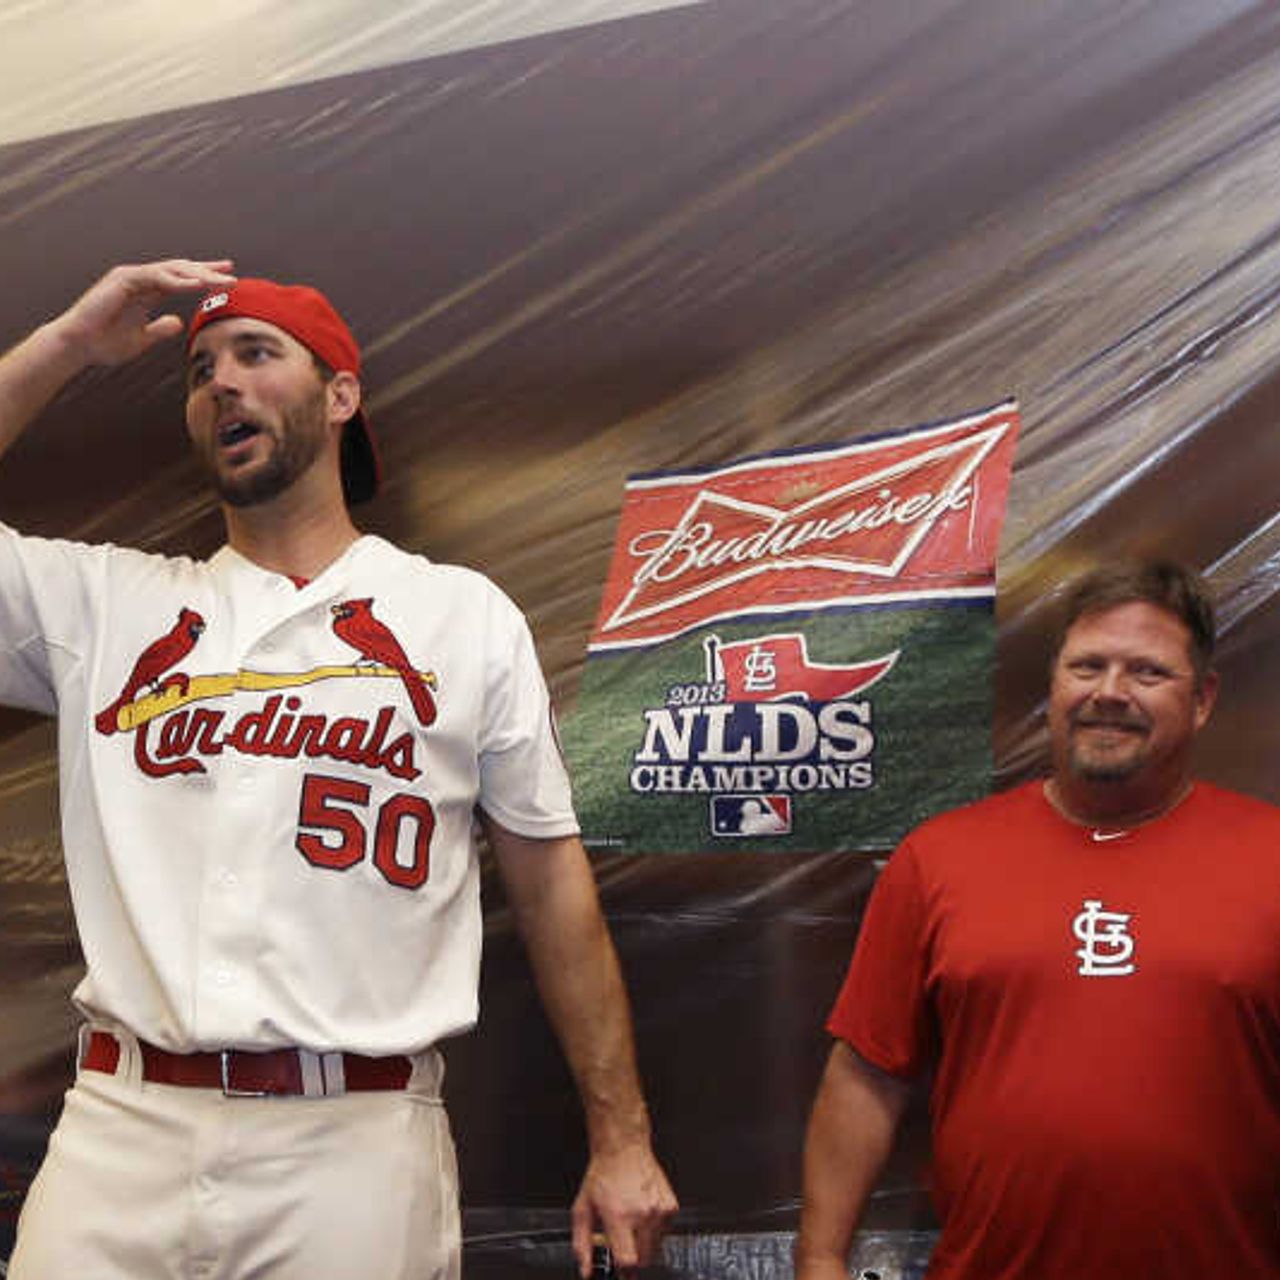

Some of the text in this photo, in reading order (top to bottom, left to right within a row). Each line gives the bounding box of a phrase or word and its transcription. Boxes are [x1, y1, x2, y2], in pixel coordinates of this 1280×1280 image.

[628, 484, 972, 584] Budweiser
[667, 685, 725, 706] 2013
[134, 696, 422, 778] Cardinals
[635, 701, 874, 762] NLDS
[630, 764, 873, 792] CHAMPIONS
[296, 773, 436, 891] 50
